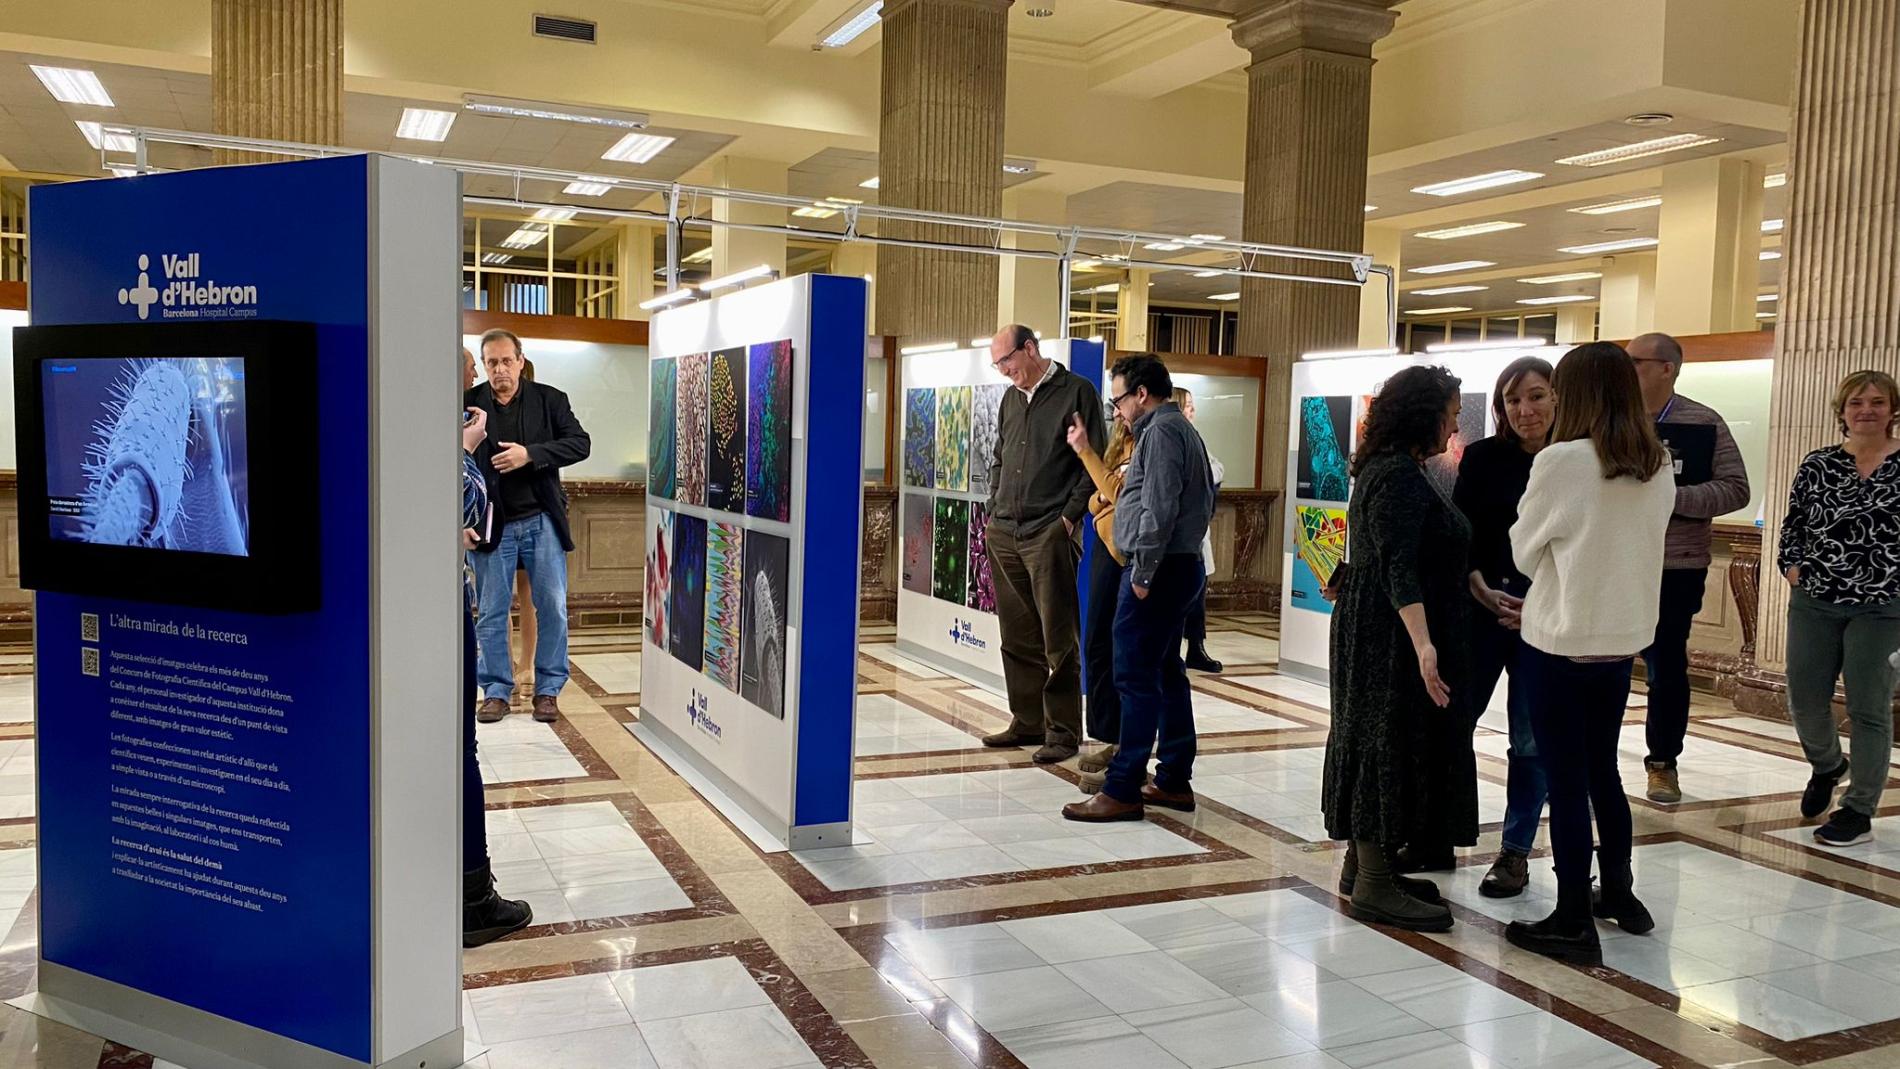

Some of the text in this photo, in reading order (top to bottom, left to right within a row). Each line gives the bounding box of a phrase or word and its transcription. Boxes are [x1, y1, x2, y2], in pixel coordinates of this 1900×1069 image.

[162, 253, 199, 278] Vall
[162, 280, 257, 306] d'Hebron
[163, 307, 257, 319] Barcelona Hospital Campus
[110, 613, 248, 645] L'altra mirada de la recerca
[961, 620, 971, 632] Vall
[110, 665, 119, 673] del
[120, 666, 143, 678] Concurs
[212, 681, 221, 690] del
[222, 682, 247, 695] Campus
[248, 687, 260, 696] Vall
[186, 661, 209, 673] celebra
[210, 665, 218, 674] els
[219, 667, 231, 676] més
[241, 669, 253, 679] deu
[254, 673, 269, 683] anys
[143, 687, 168, 697] personal
[207, 696, 236, 709] d'aquesta
[267, 706, 284, 717] dona
[136, 715, 148, 724] amb
[149, 717, 171, 729] imatges
[181, 724, 194, 733] gran
[195, 726, 210, 735] valor
[145, 703, 167, 712] resultat
[183, 709, 196, 718] seva
[197, 712, 220, 722] recerca
[221, 714, 231, 724] des
[232, 716, 246, 726] d'un
[247, 721, 262, 729] punt
[272, 724, 288, 734] vista
[111, 732, 121, 741] Les
[200, 750, 215, 759] relat
[256, 762, 268, 771] que
[268, 763, 278, 772] els
[251, 777, 263, 785] seu
[263, 778, 273, 787] dia
[216, 809, 239, 820] recerca
[239, 814, 259, 824] queda
[260, 818, 290, 831] reflectida
[219, 825, 230, 834] que
[231, 828, 242, 836] ens
[120, 840, 143, 851] recerca
[177, 853, 193, 863] salut
[194, 856, 204, 865] del
[209, 838, 219, 846] cos
[212, 876, 234, 888] durant
[259, 888, 271, 898] deu
[272, 893, 287, 903] anys
[221, 894, 232, 904] del
[232, 898, 243, 907] seu
